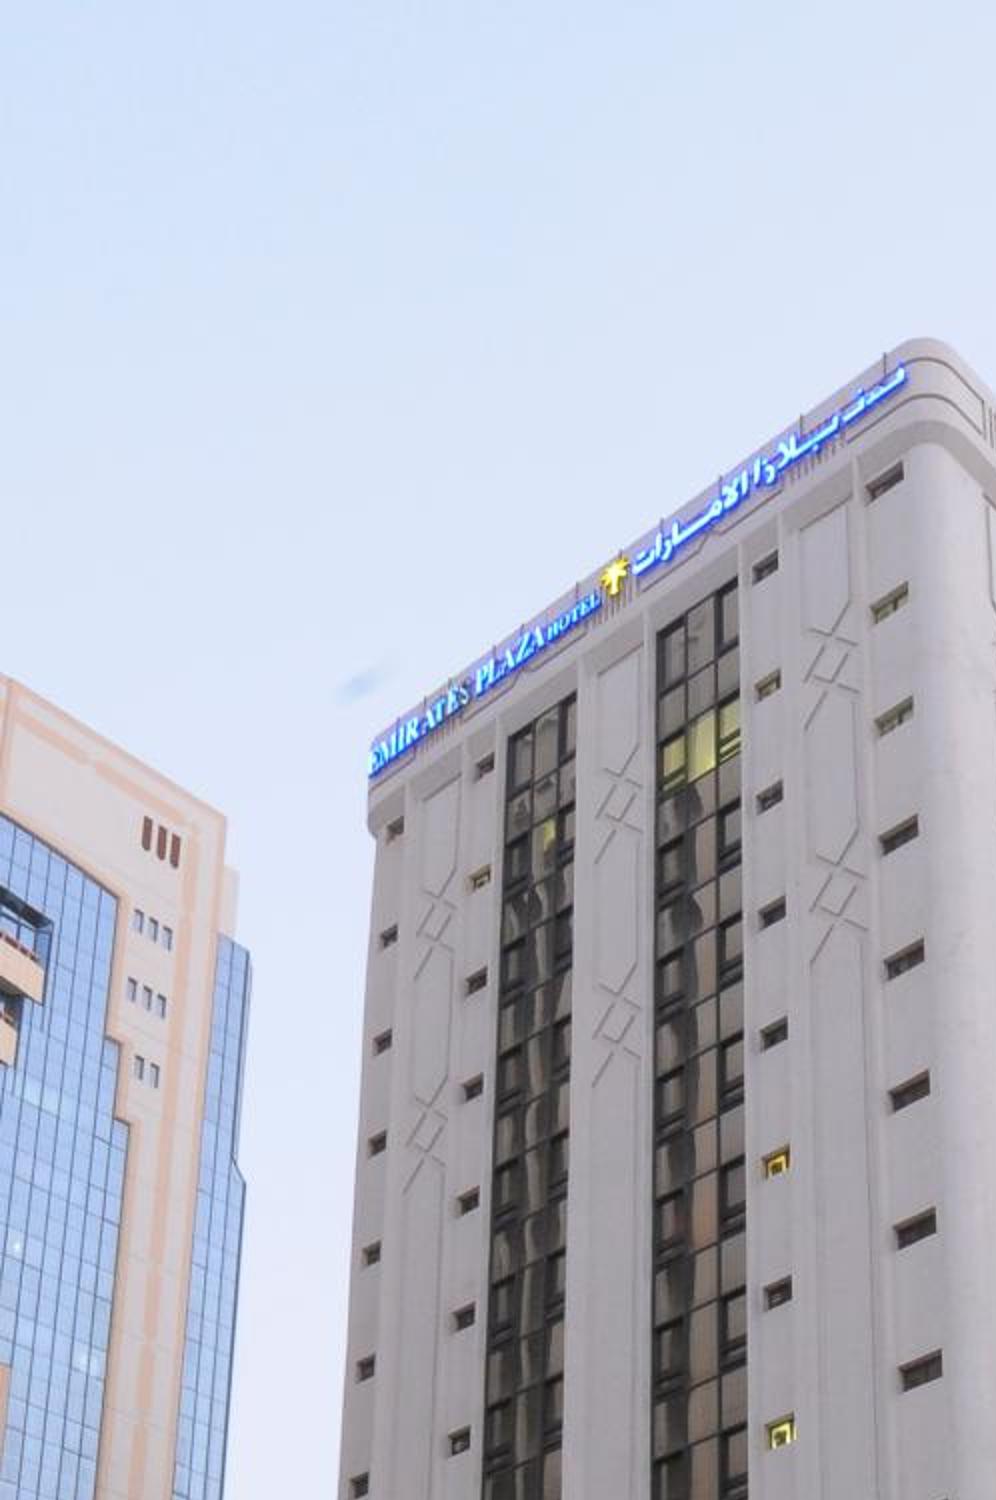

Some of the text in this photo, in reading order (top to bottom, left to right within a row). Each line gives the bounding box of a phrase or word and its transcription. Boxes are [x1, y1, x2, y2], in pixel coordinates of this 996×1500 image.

[369, 592, 602, 778] EMIRATES PLAZA HOTEL
